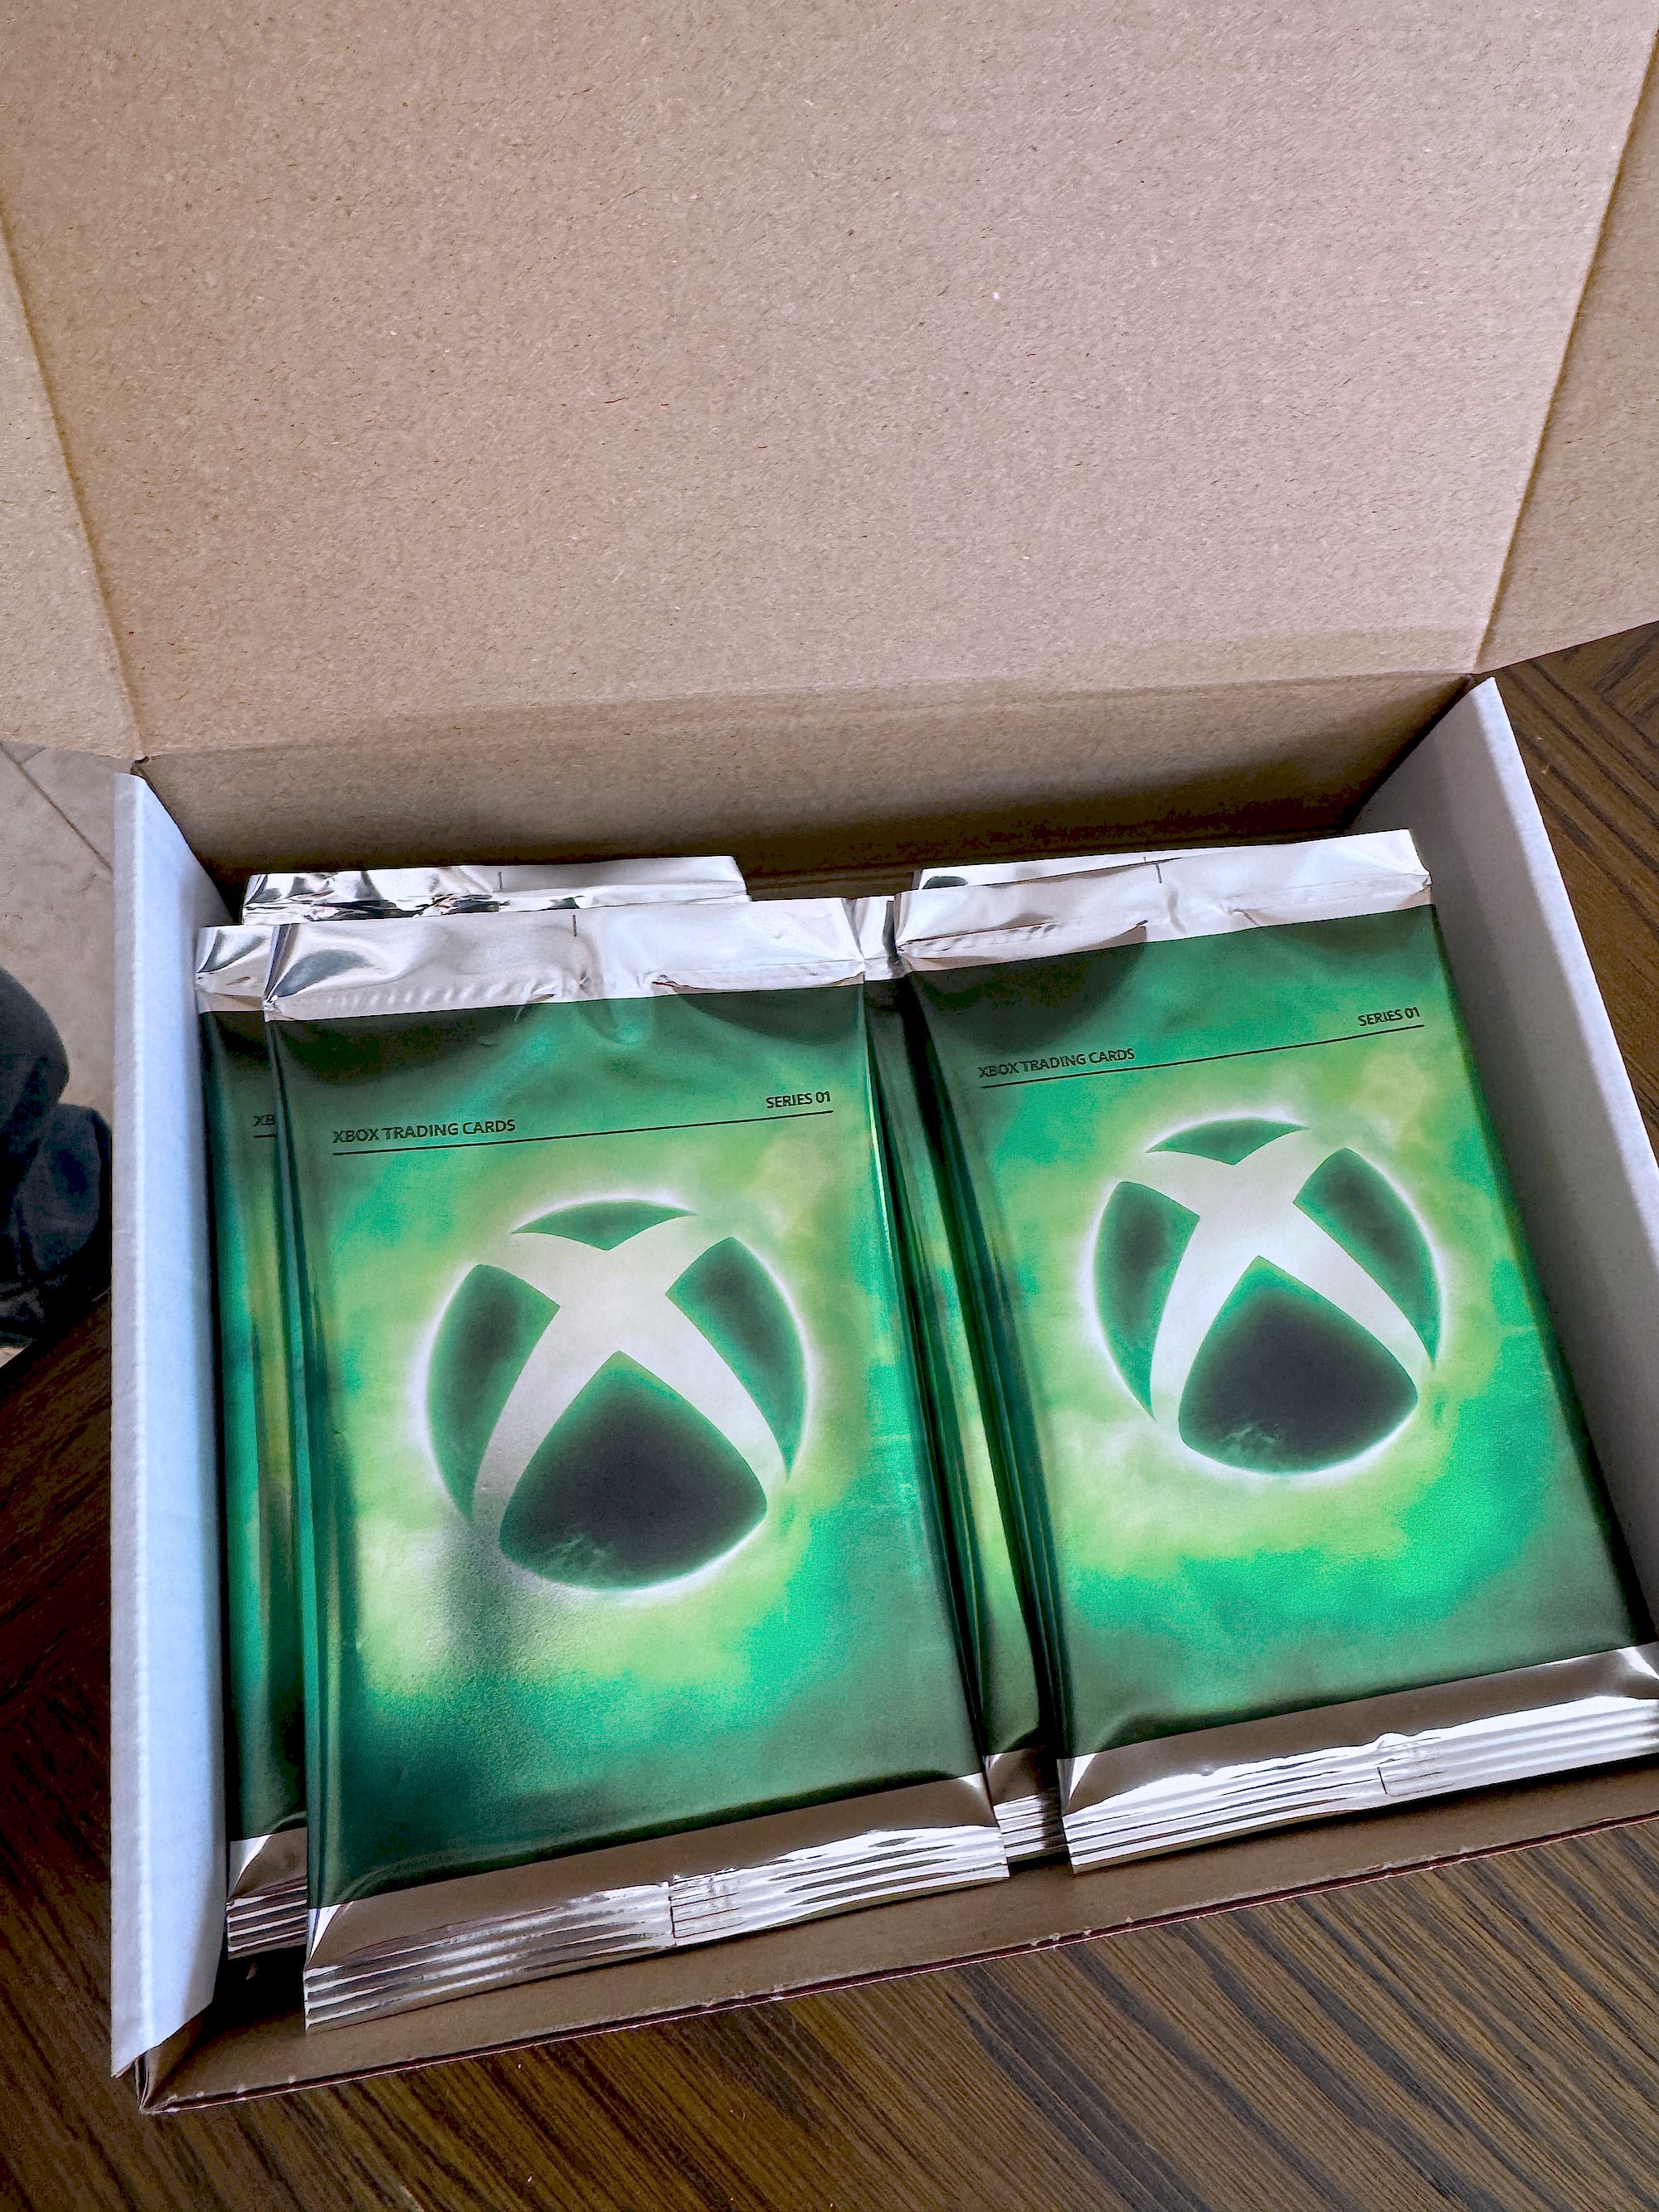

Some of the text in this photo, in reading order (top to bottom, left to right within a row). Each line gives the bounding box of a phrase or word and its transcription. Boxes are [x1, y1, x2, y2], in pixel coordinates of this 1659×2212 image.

[1358, 1007, 1420, 1026] SERIES 01
[978, 1048, 1136, 1078] XBOX TRADING CARDS
[766, 1091, 830, 1108] SERIES 01
[252, 1114, 275, 1126] XB
[332, 1120, 516, 1144] XBOX TRADING CARDS
